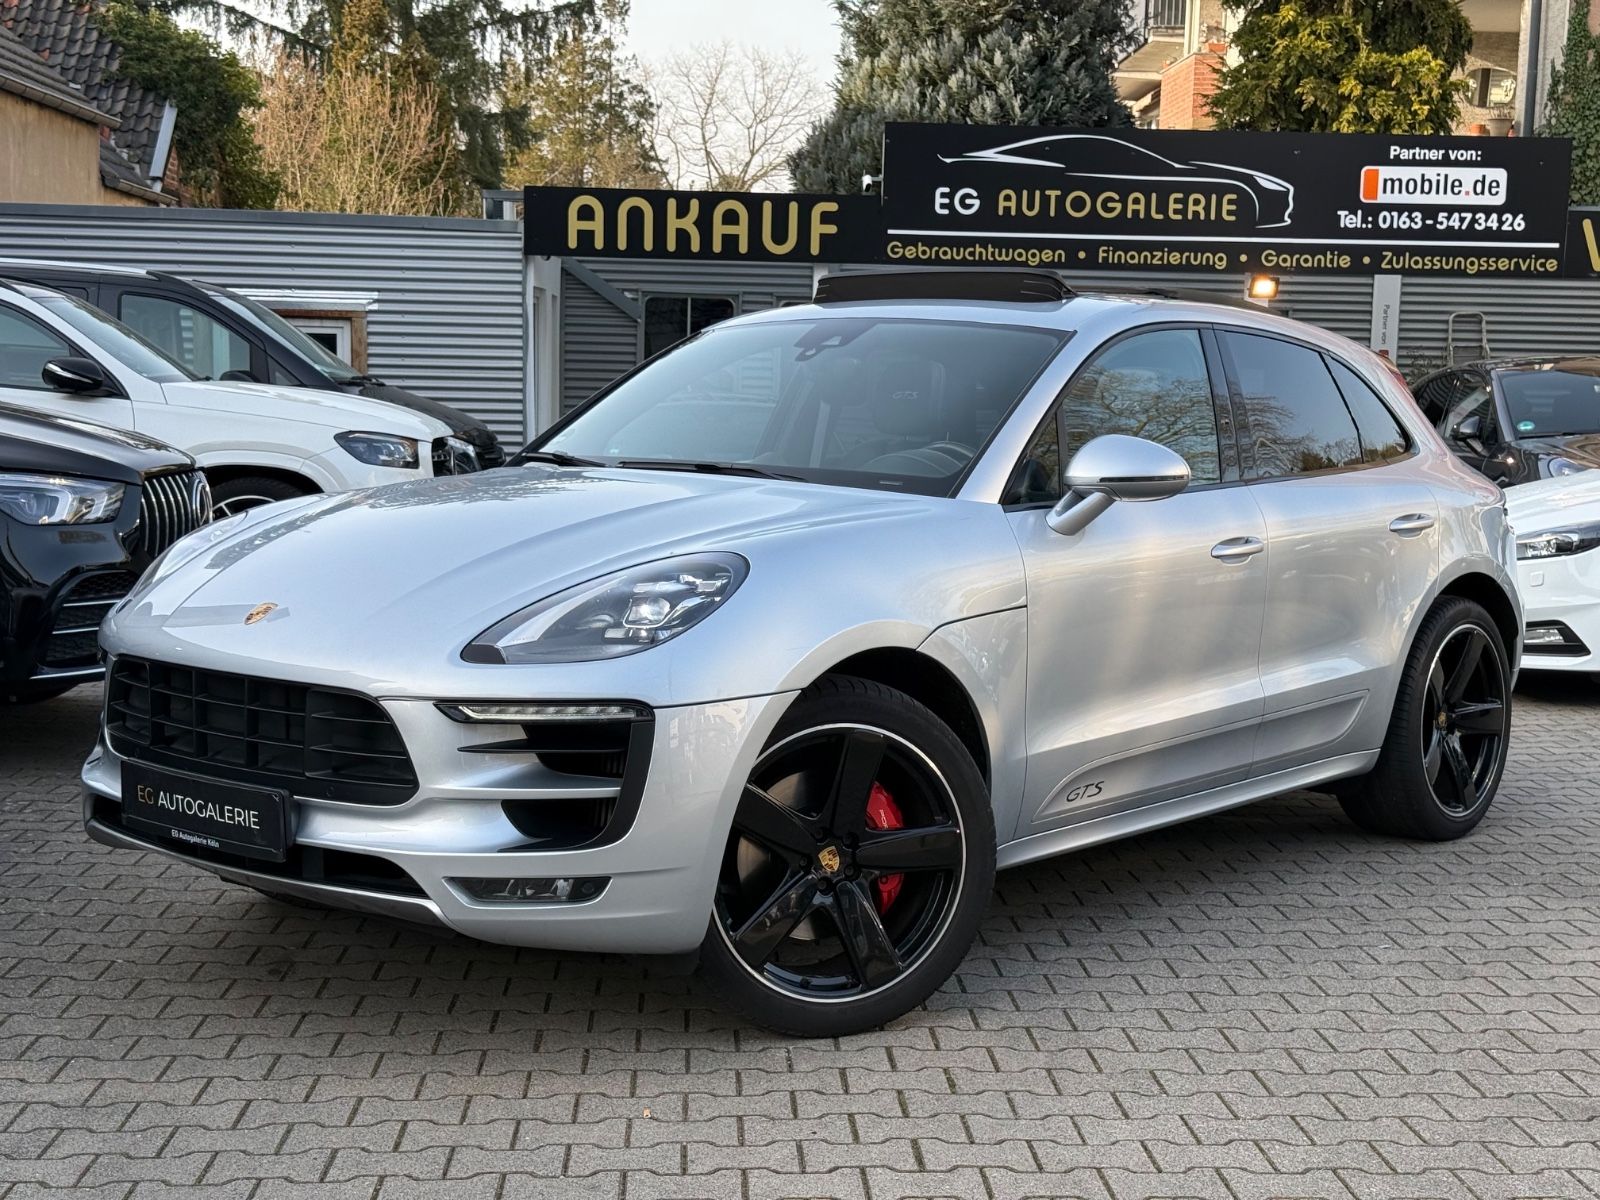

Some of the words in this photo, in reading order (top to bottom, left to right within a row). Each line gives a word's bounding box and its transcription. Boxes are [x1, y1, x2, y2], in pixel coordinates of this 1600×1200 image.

[1389, 145, 1446, 161] Partner
[1448, 149, 1482, 161] von:
[1382, 172, 1501, 197] mobile.de
[934, 186, 981, 216] EG
[998, 189, 1238, 222] AUTOGALERIE
[567, 194, 840, 256] ANKAUF
[1336, 209, 1373, 229] Tel.:
[886, 240, 1066, 266] Gebrauchtwagen
[1098, 246, 1228, 270] Finanzierung
[1260, 250, 1352, 269] Garantie
[1380, 251, 1559, 275] Zulassungsservice
[1065, 780, 1105, 803] GTS
[137, 785, 154, 805] EG
[158, 791, 260, 829] AUTOGALERIE
[171, 829, 179, 838] EG
[179, 831, 207, 844] Autogalerie
